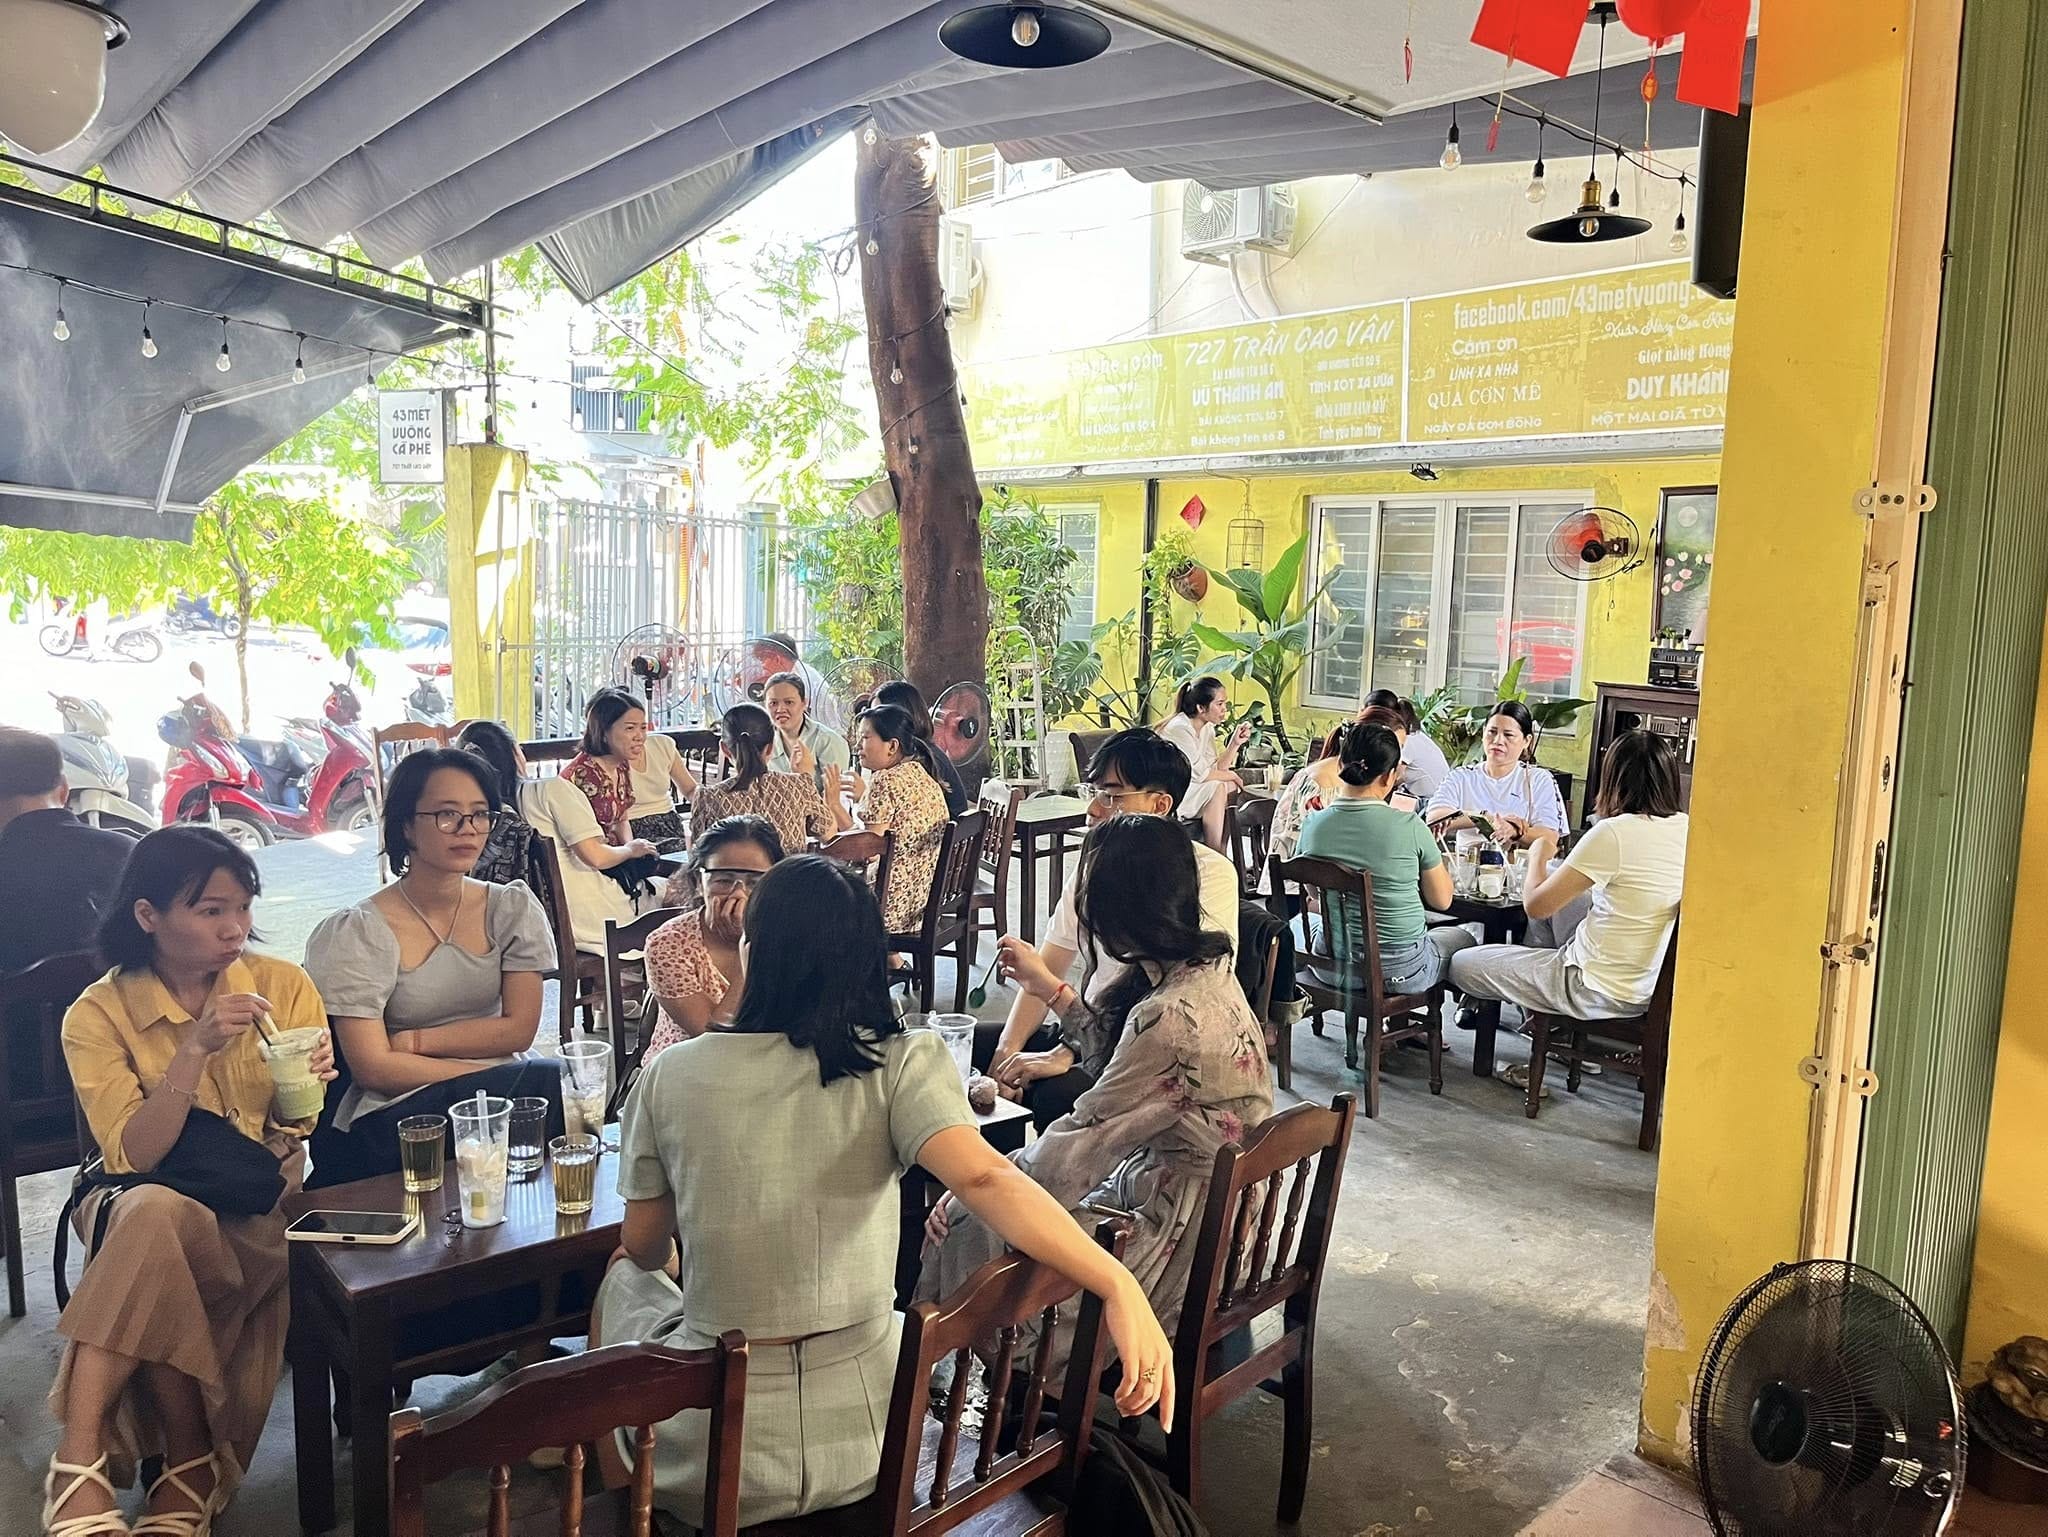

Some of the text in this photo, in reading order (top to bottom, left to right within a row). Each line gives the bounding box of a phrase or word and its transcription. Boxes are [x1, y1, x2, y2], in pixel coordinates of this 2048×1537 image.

[1185, 338, 1227, 368] 727
[1295, 326, 1339, 353] CAO
[1346, 312, 1395, 347] VÂN
[1264, 380, 1285, 400] AN
[1512, 380, 1541, 402] MÊ
[1627, 375, 1665, 400] DUY
[1628, 409, 1656, 423] MAI
[1278, 430, 1285, 441] 8
